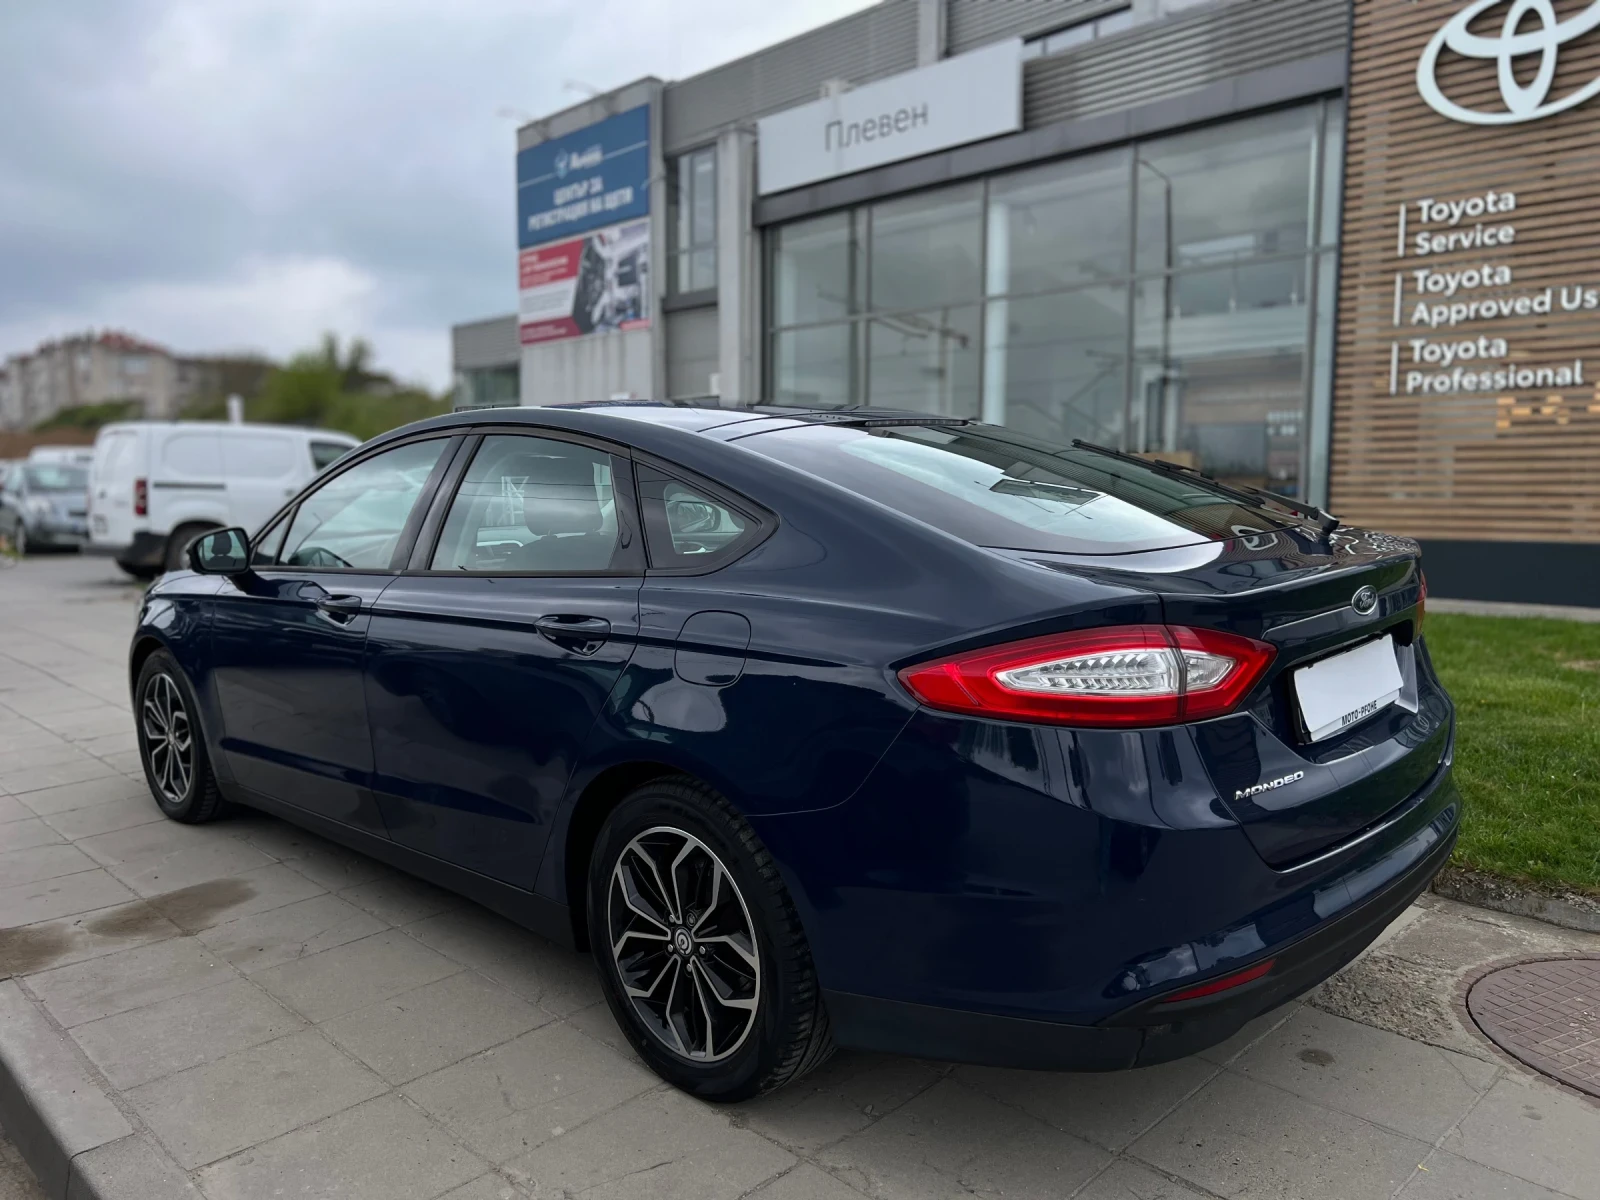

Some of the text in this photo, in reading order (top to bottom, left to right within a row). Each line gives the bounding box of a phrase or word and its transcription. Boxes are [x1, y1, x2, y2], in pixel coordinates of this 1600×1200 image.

[824, 103, 928, 152] Плевен
[1416, 190, 1516, 225] Toyota
[1415, 223, 1515, 255] Service
[1413, 263, 1512, 296] Toyota
[1411, 287, 1552, 328] Approved
[1408, 335, 1507, 367] Toyota
[1406, 359, 1583, 394] Professional
[1234, 770, 1305, 801] MONDEO
